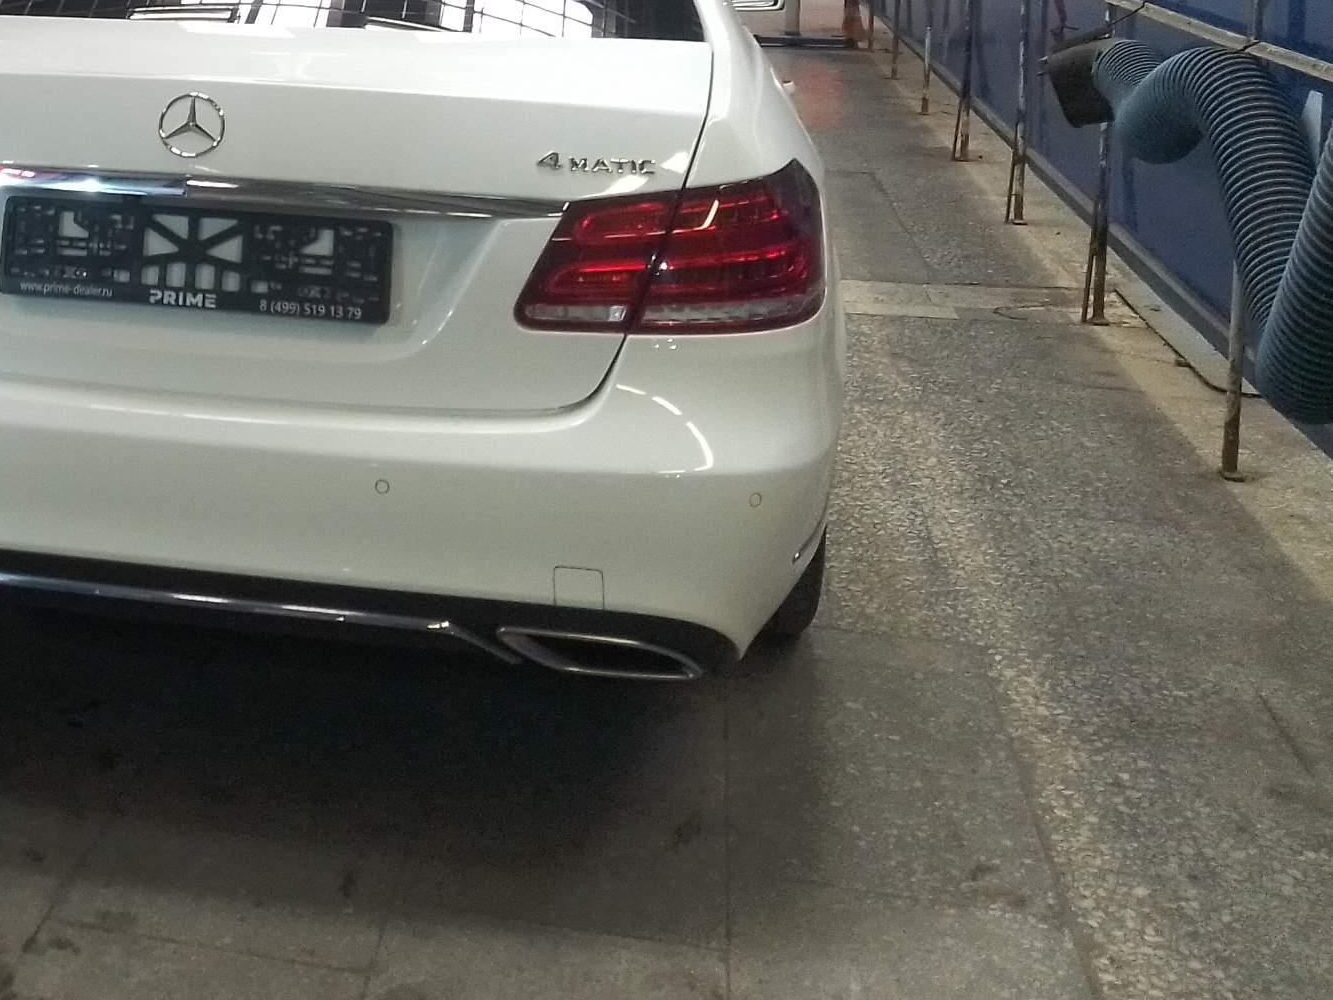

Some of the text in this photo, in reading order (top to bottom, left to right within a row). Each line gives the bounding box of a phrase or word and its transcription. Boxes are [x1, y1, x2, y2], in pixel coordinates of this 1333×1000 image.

[148, 289, 217, 309] PRIME
[259, 299, 362, 321] 8 (499) 519 13 79
